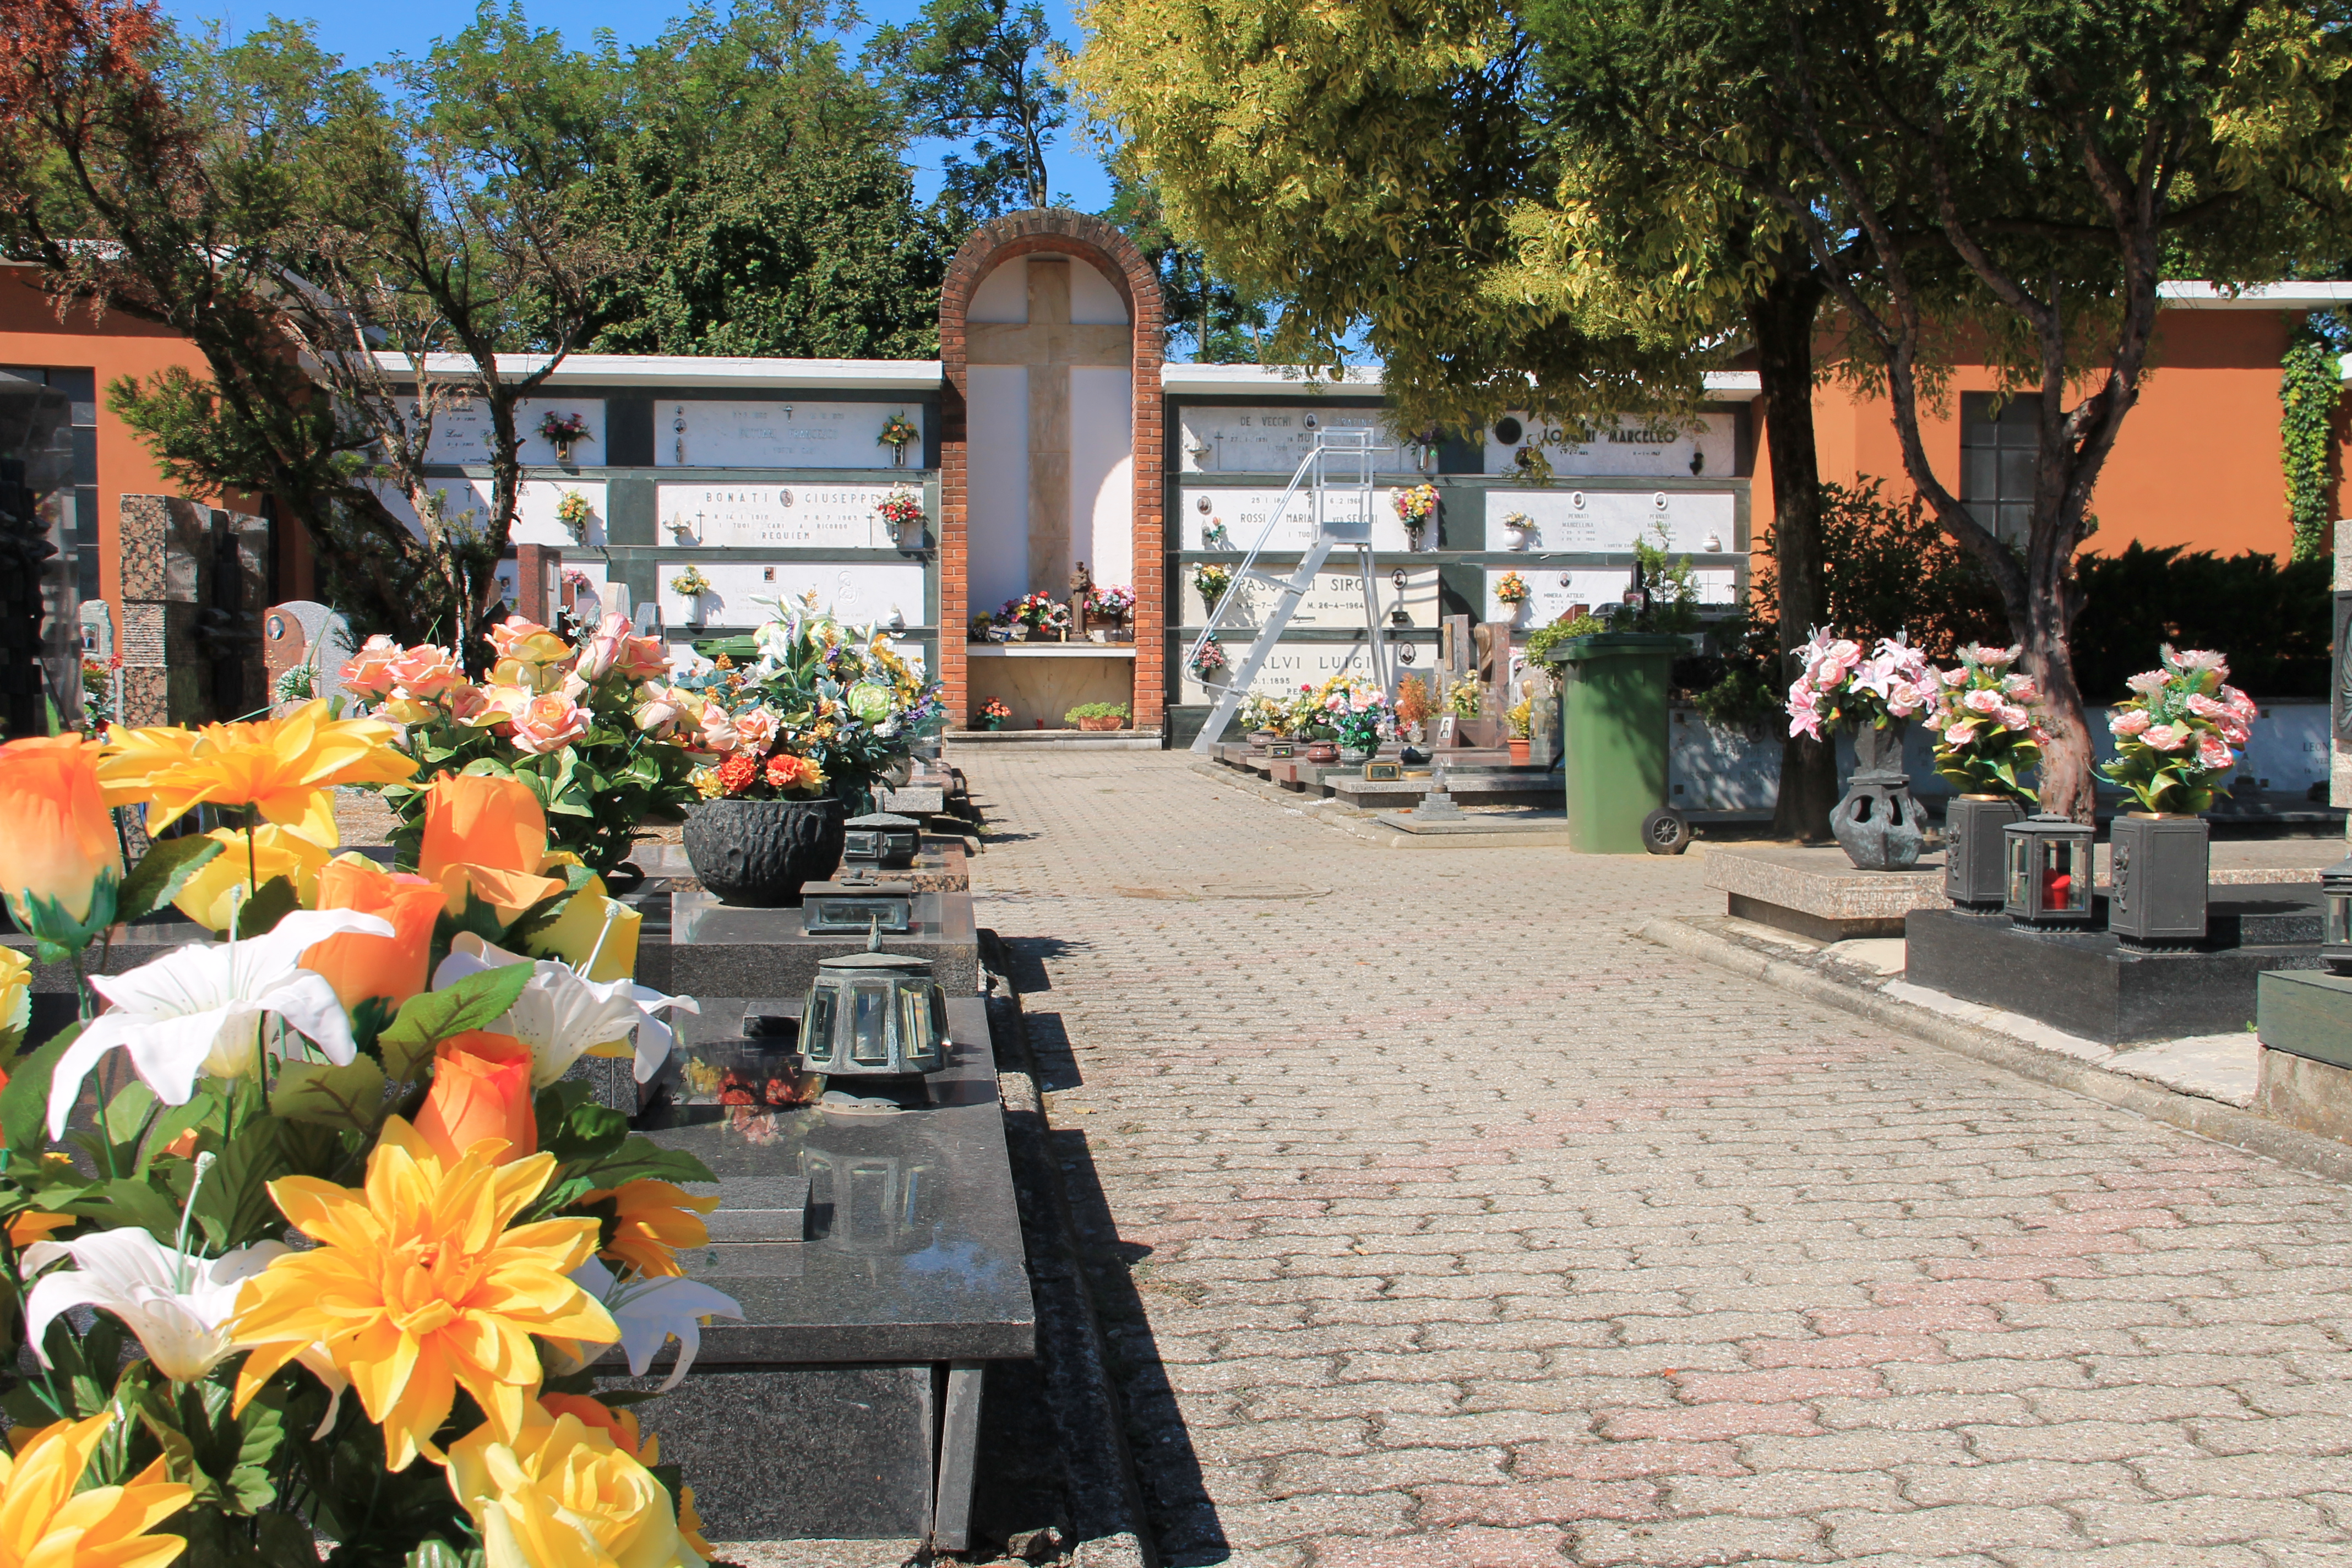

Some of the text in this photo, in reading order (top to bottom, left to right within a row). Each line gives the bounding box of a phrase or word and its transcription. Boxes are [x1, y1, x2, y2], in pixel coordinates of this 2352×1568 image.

[1240, 416, 1251, 426] DE
[1261, 416, 1291, 427] VECCHI
[788, 428, 839, 439] FRANCESCO
[1608, 429, 1675, 443] MARCELLO
[705, 492, 876, 504] BONATI GIUSEPPE
[1240, 513, 1266, 523] ROSSI
[1286, 513, 1313, 523] MARIA
[1318, 656, 1370, 669] LUIGI
